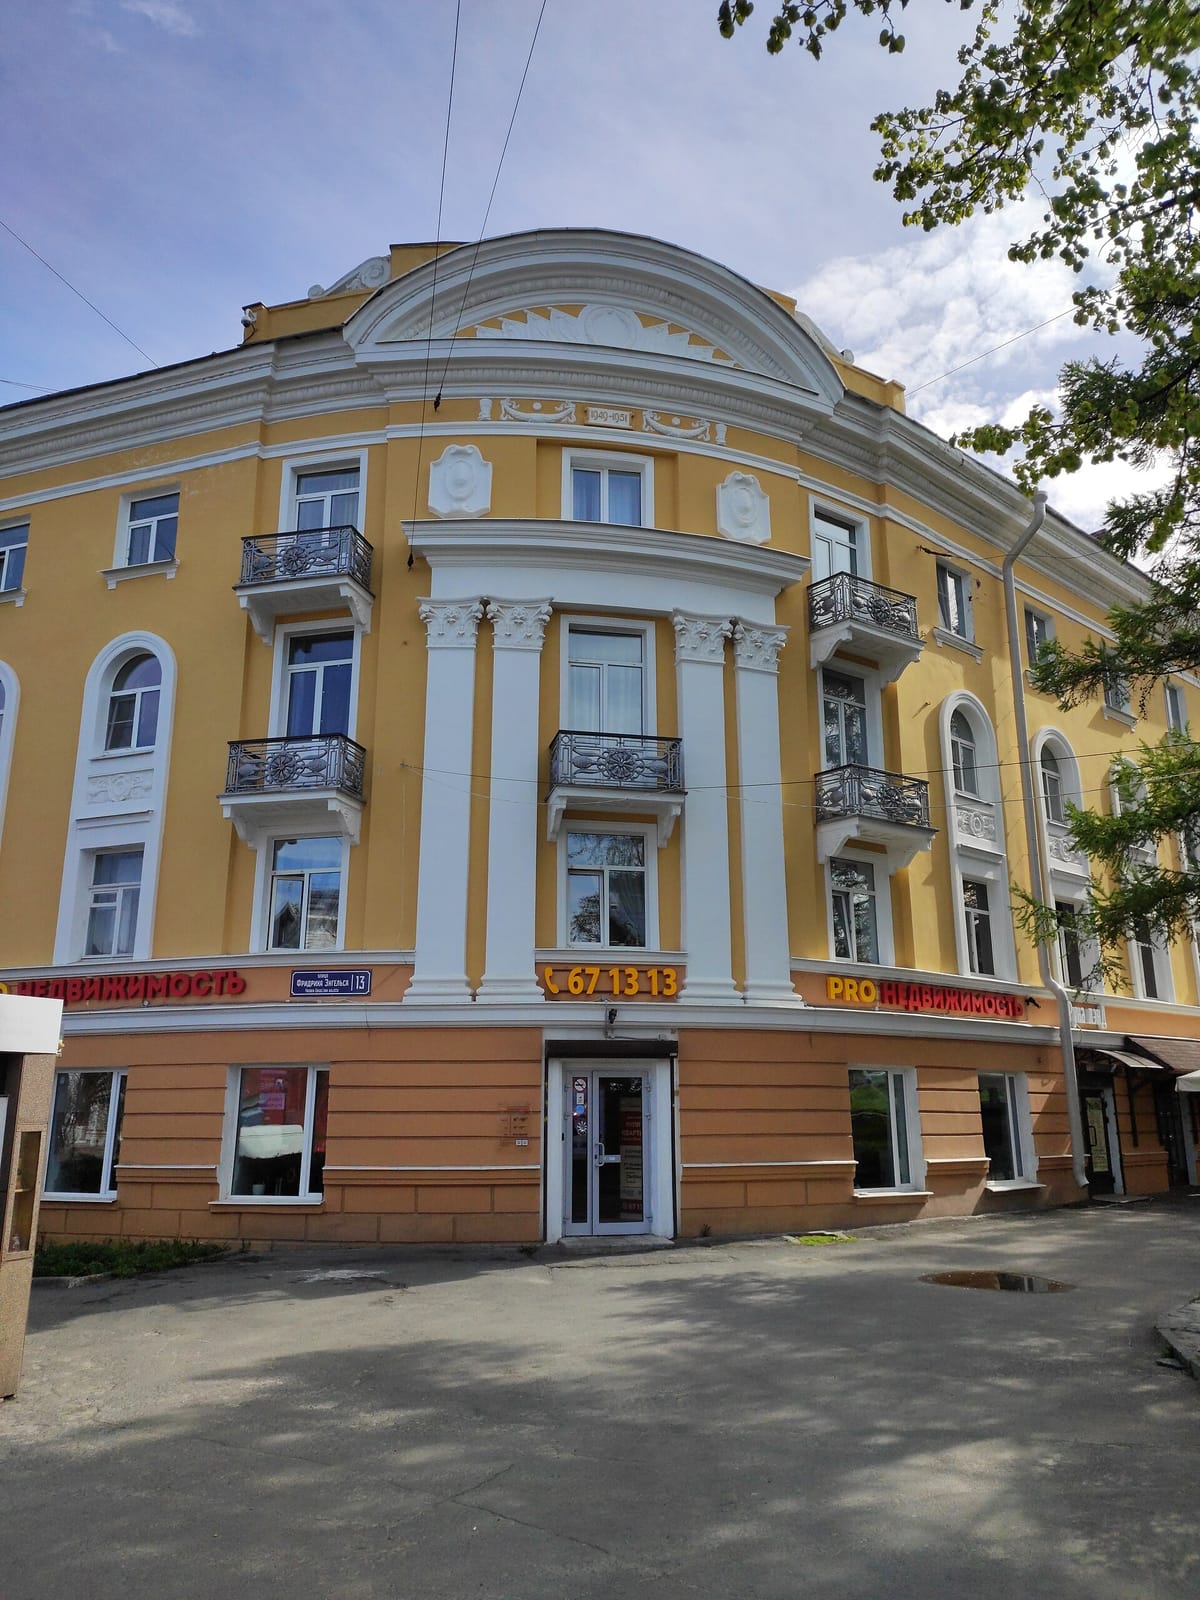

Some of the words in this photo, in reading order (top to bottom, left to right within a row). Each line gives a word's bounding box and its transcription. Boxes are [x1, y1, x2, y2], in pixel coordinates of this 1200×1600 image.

[355, 975, 365, 990] 13
[568, 967, 600, 995] 67
[608, 967, 639, 996] 13
[647, 967, 677, 997] 13
[827, 976, 876, 1003] PRO
[880, 981, 1024, 1017] НЕДВИЖИМОСТЬ
